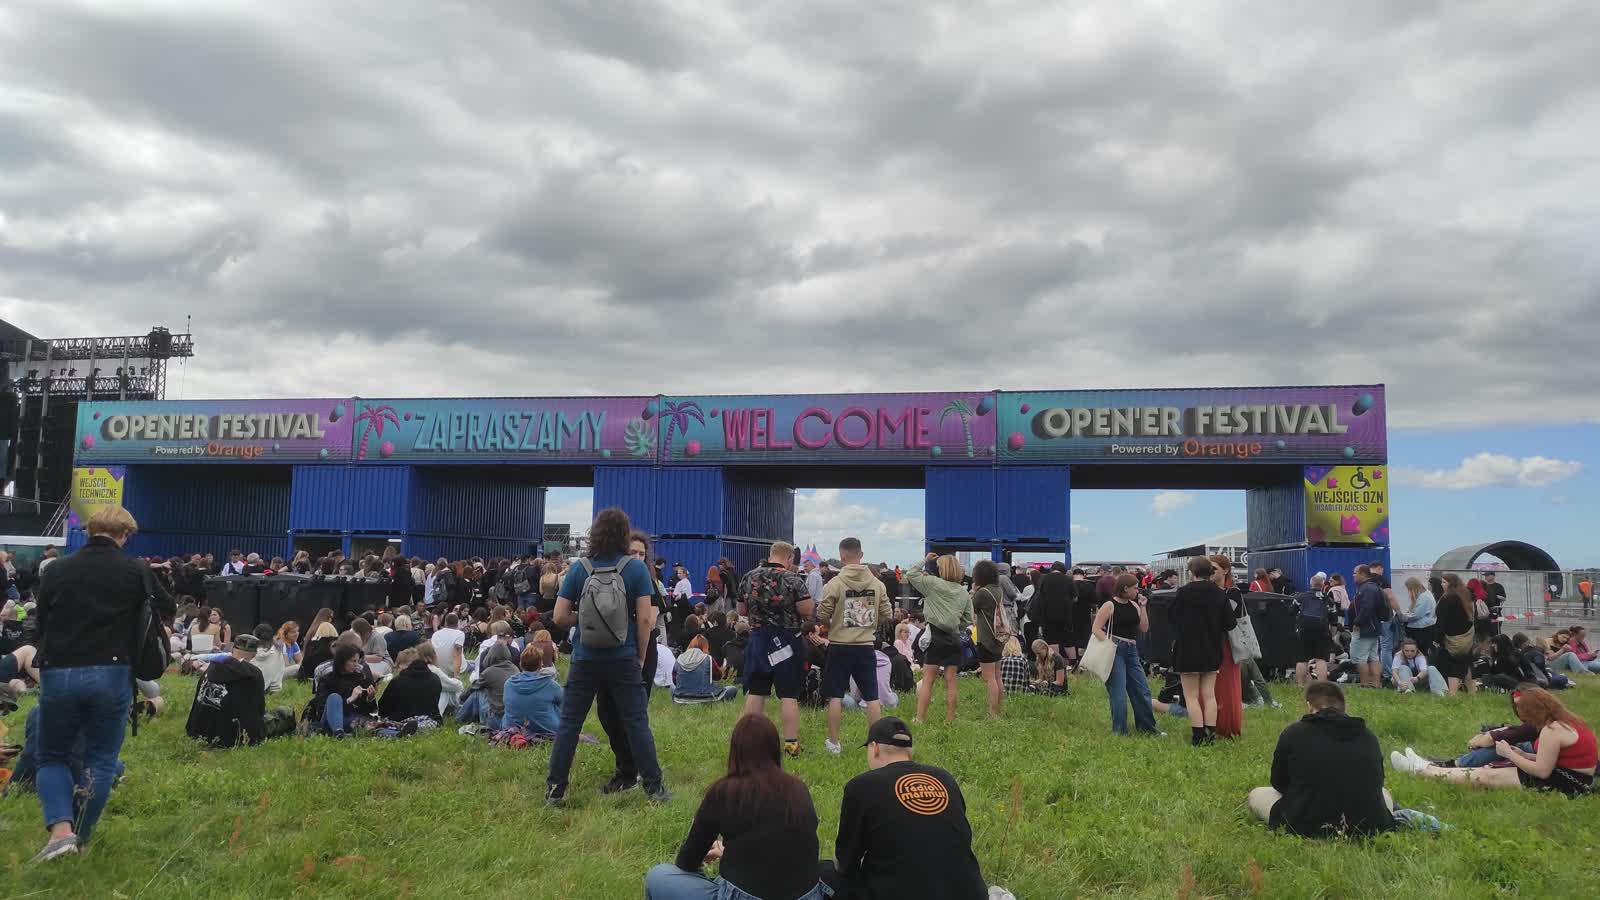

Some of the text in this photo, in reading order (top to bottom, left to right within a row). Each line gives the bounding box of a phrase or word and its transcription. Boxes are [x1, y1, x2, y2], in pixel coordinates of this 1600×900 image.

[107, 412, 325, 440] OPEN'ER FESTIVAL
[413, 409, 607, 450] ZAPRASZAMY
[722, 406, 931, 449] WELCOME
[1041, 403, 1349, 438] OPEN'ER FESTIVAL
[155, 440, 264, 457] Powered by Orange
[1111, 438, 1262, 458] Powered by Orange
[1313, 488, 1360, 504] WEJŚCIE
[1314, 504, 1368, 512] DISABLED ACCESS
[901, 790, 947, 801] marmur
[905, 784, 935, 793] radio
